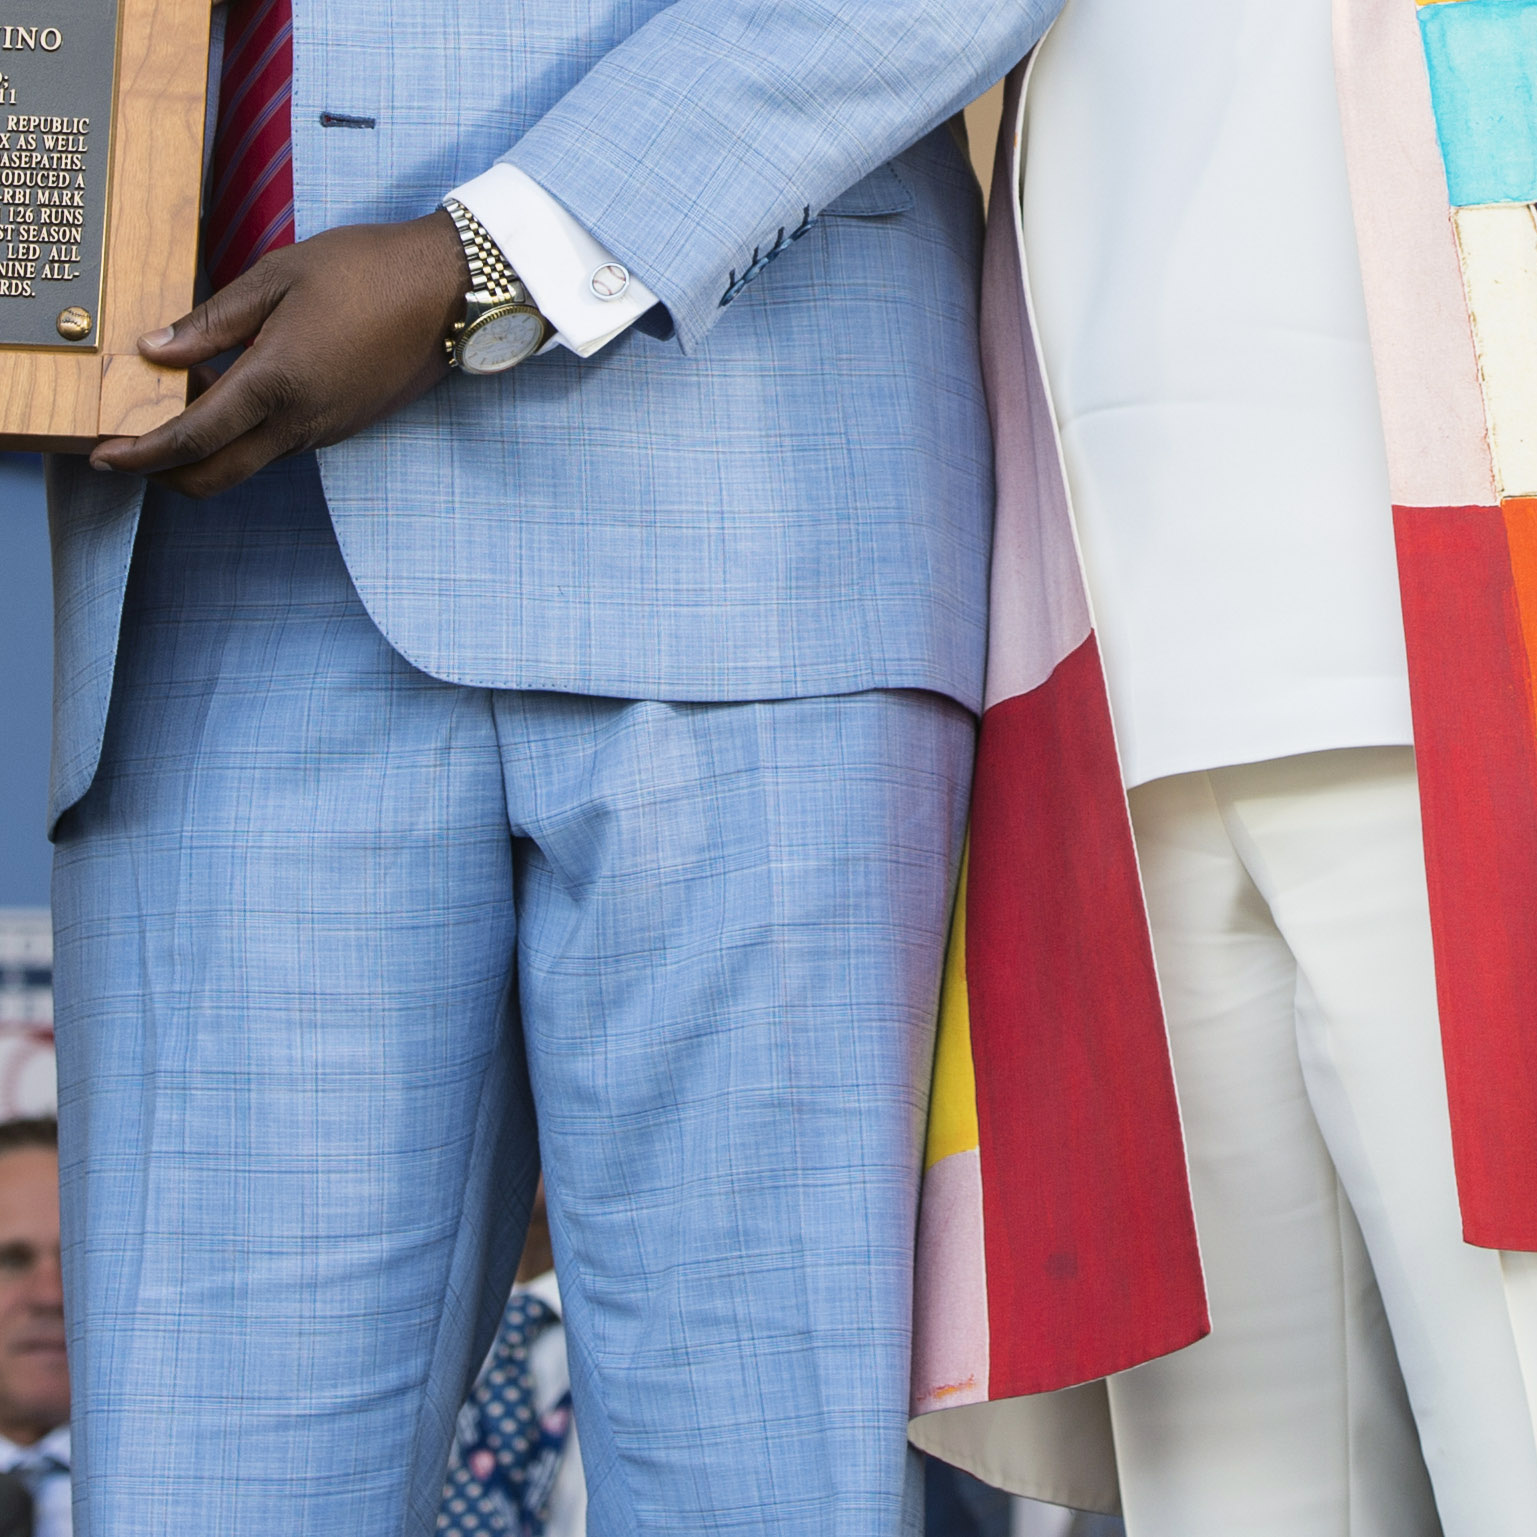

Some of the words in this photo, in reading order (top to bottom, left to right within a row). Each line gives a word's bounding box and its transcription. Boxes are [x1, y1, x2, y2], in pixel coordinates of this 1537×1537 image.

[6, 114, 90, 134] REPUBLIC
[16, 133, 37, 150] AS
[42, 134, 88, 152] WELL
[74, 172, 85, 188] A
[36, 189, 85, 207] MARK
[9, 206, 34, 223] 126
[40, 207, 84, 225] RUNS
[19, 224, 82, 243] SEASON
[7, 242, 40, 260] LED
[48, 244, 81, 261] ALL
[41, 263, 80, 280] ALL-
